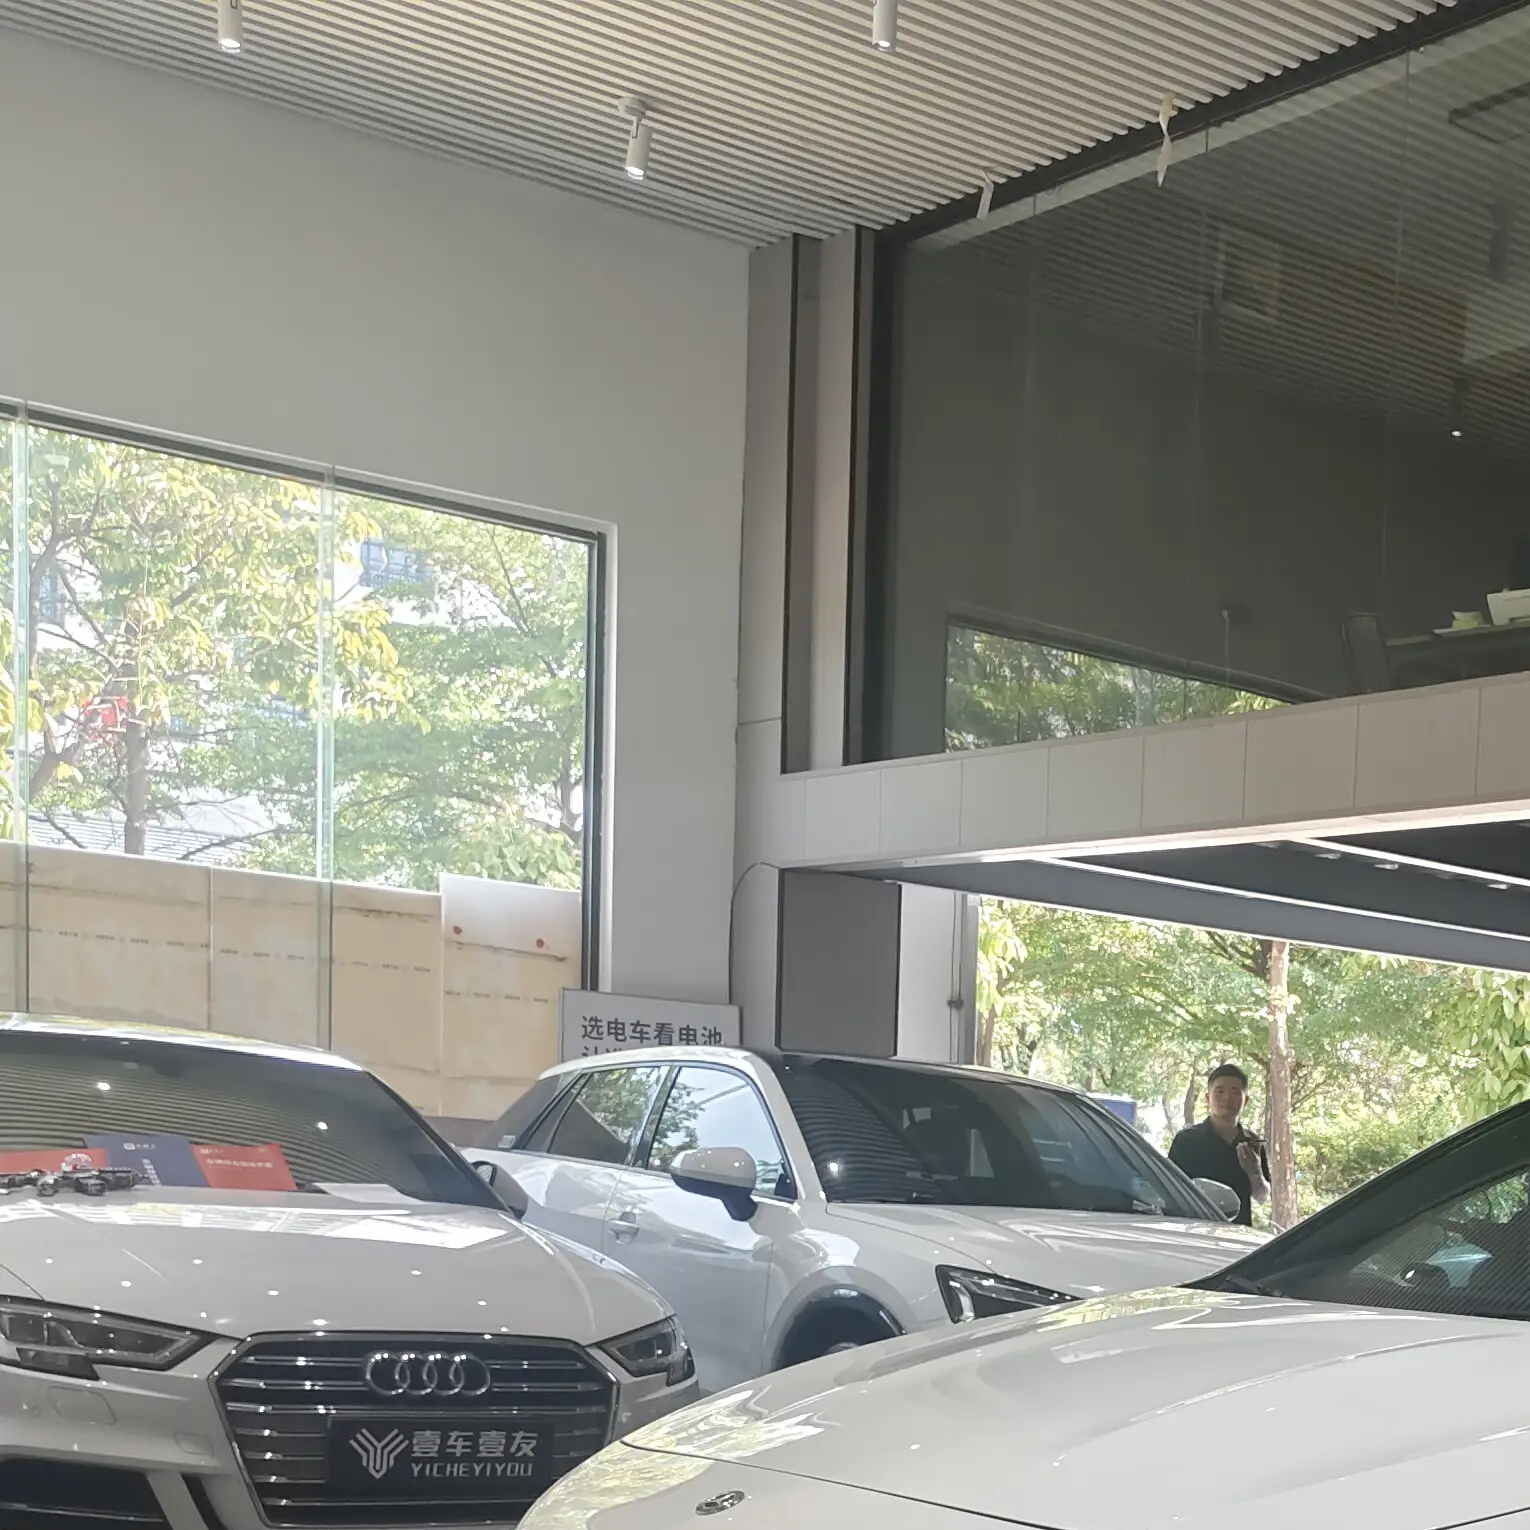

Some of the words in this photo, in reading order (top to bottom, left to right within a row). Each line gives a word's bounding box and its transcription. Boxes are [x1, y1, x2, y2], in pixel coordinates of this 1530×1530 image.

[581, 1015, 723, 1046] 选电车看电池
[411, 1430, 539, 1457] 壹车壹友
[411, 1462, 533, 1477] YICHEYIYOU
